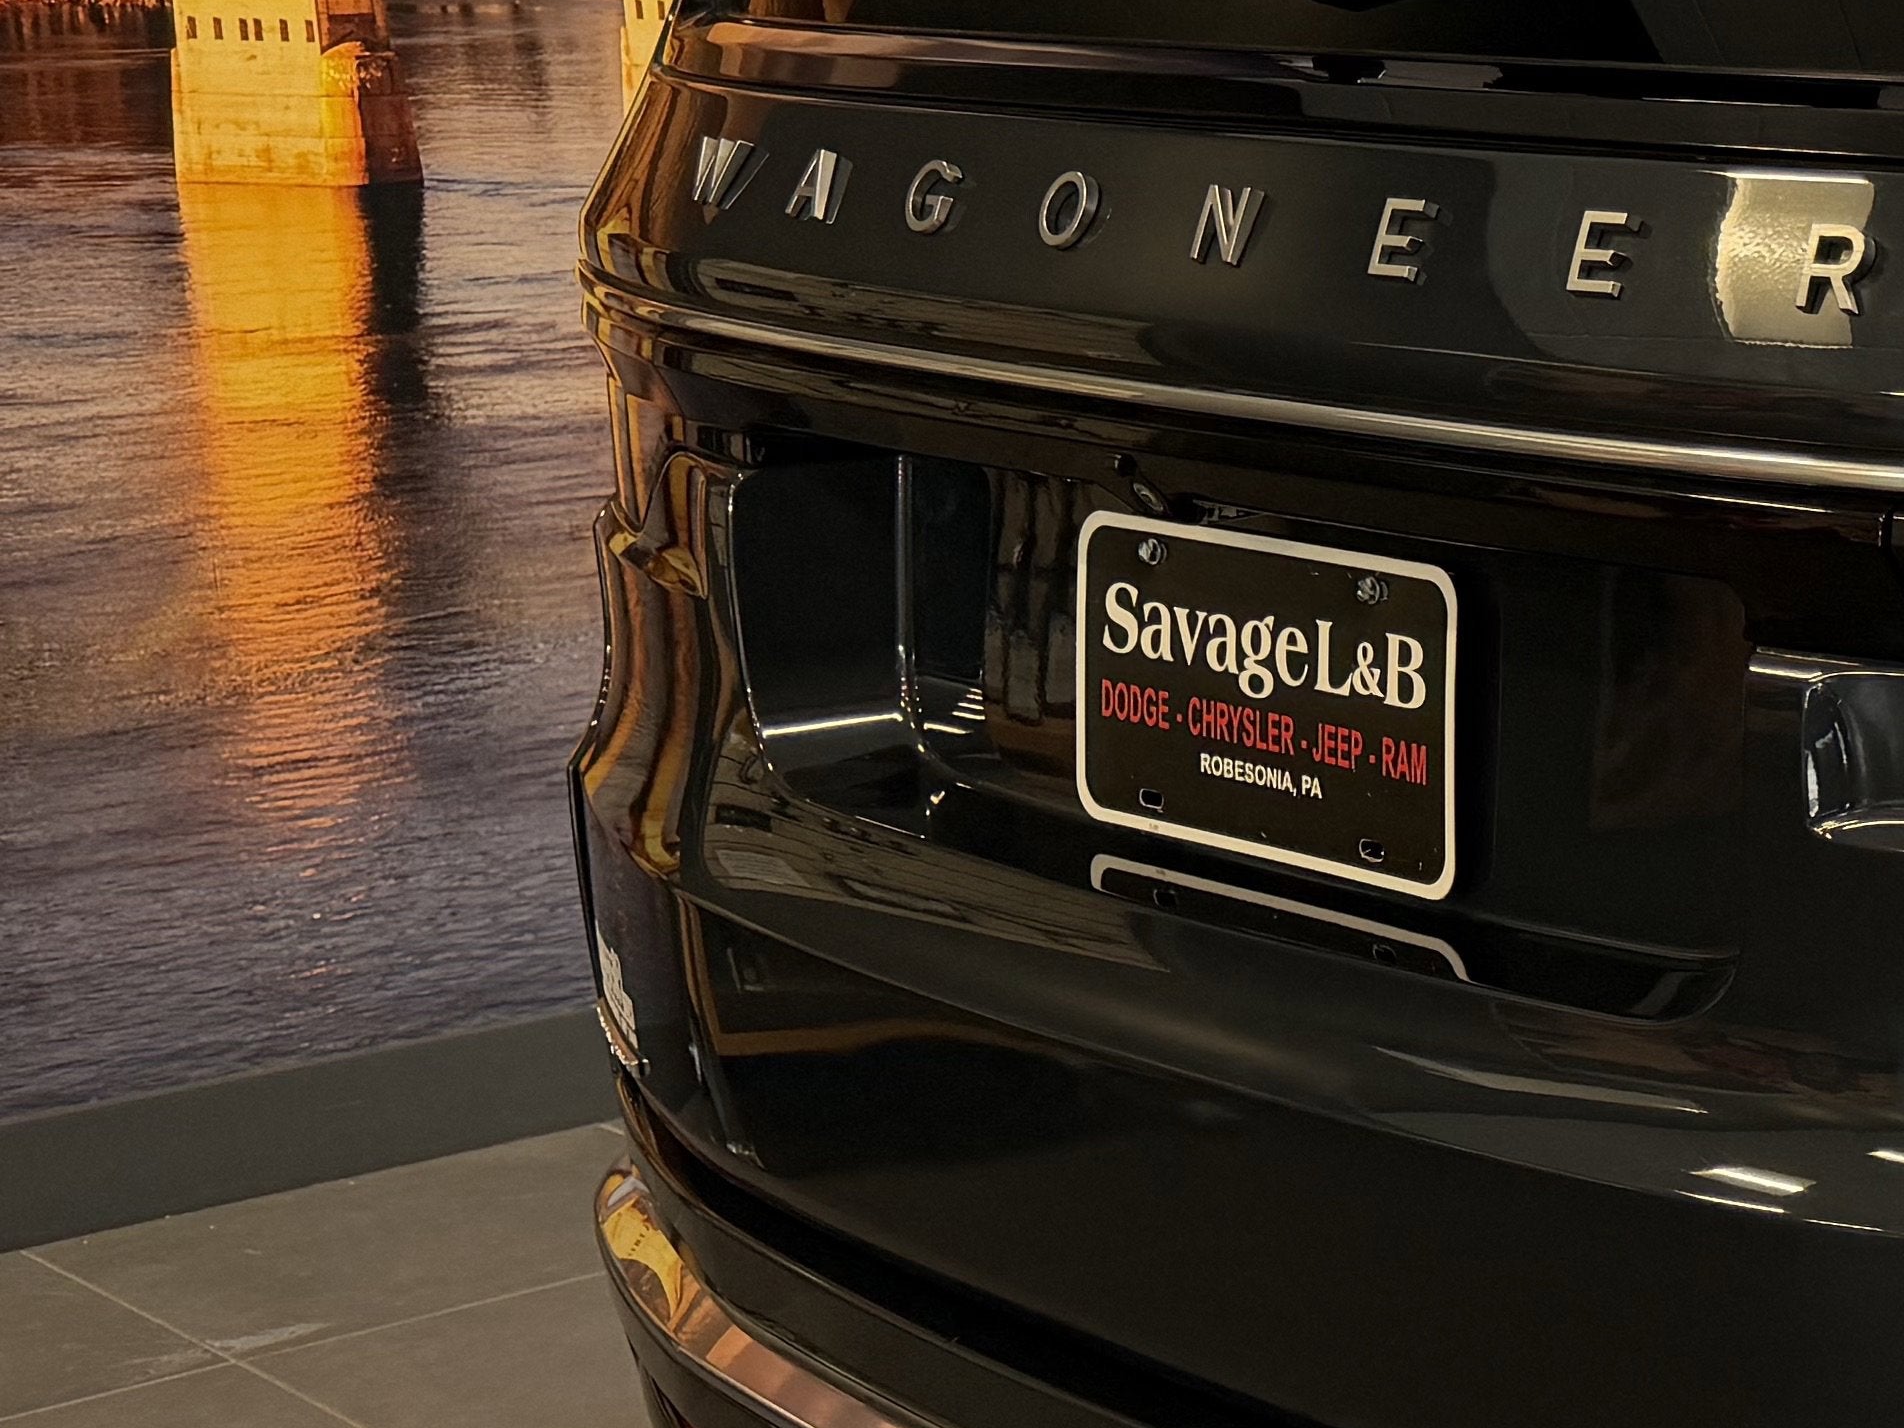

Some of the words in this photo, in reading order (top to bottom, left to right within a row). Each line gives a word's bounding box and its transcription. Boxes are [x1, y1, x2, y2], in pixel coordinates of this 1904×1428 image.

[692, 135, 1874, 315] WAGONEER
[1101, 678, 1170, 731] DODGE
[1187, 695, 1295, 756] CHRYSLER
[1312, 721, 1364, 770] JEEP
[1381, 736, 1428, 786] RAM
[1199, 752, 1297, 798] ROBESONIA,
[1301, 774, 1323, 800] PA
